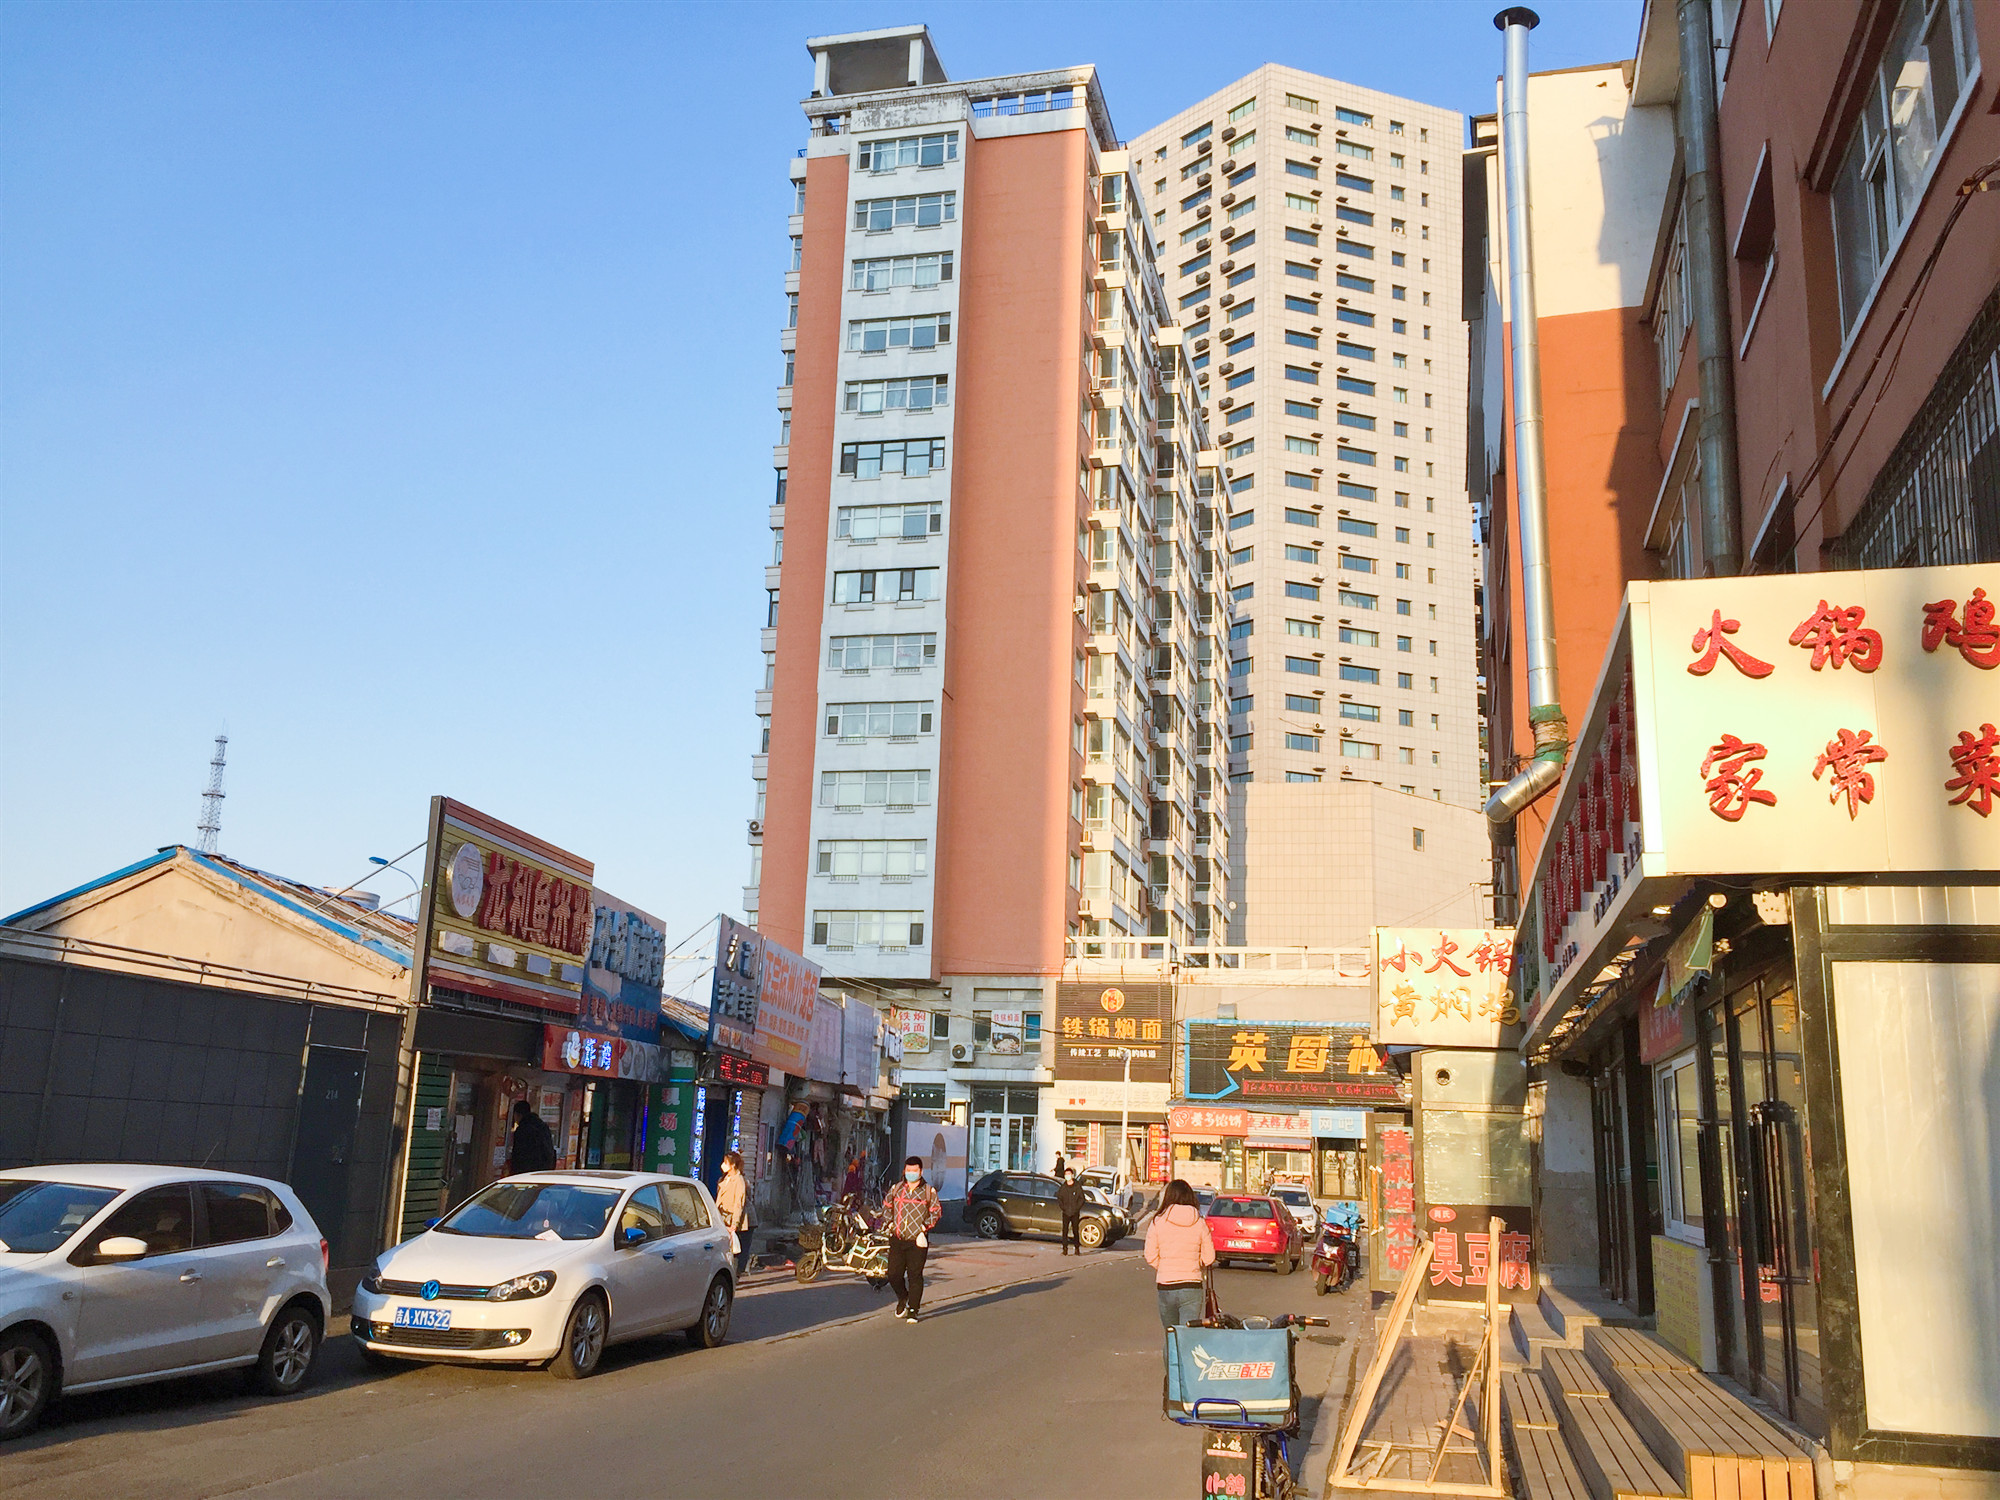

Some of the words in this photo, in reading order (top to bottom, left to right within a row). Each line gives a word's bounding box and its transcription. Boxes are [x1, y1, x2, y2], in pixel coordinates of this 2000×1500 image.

[1688, 587, 2000, 678] 火锅鸡
[1701, 723, 2000, 822] 家常菜
[1380, 930, 1513, 978] 小火锅
[1380, 979, 1519, 1027] 黄焖鸡
[1062, 1016, 1162, 1040] 铁锅焖面
[1318, 1116, 1354, 1132] 网吧
[1380, 1129, 1415, 1271] 黄焖鸡米饭
[1430, 1227, 1532, 1291] 臭豆腐
[1209, 1363, 1274, 1378] 蜂鸟配送
